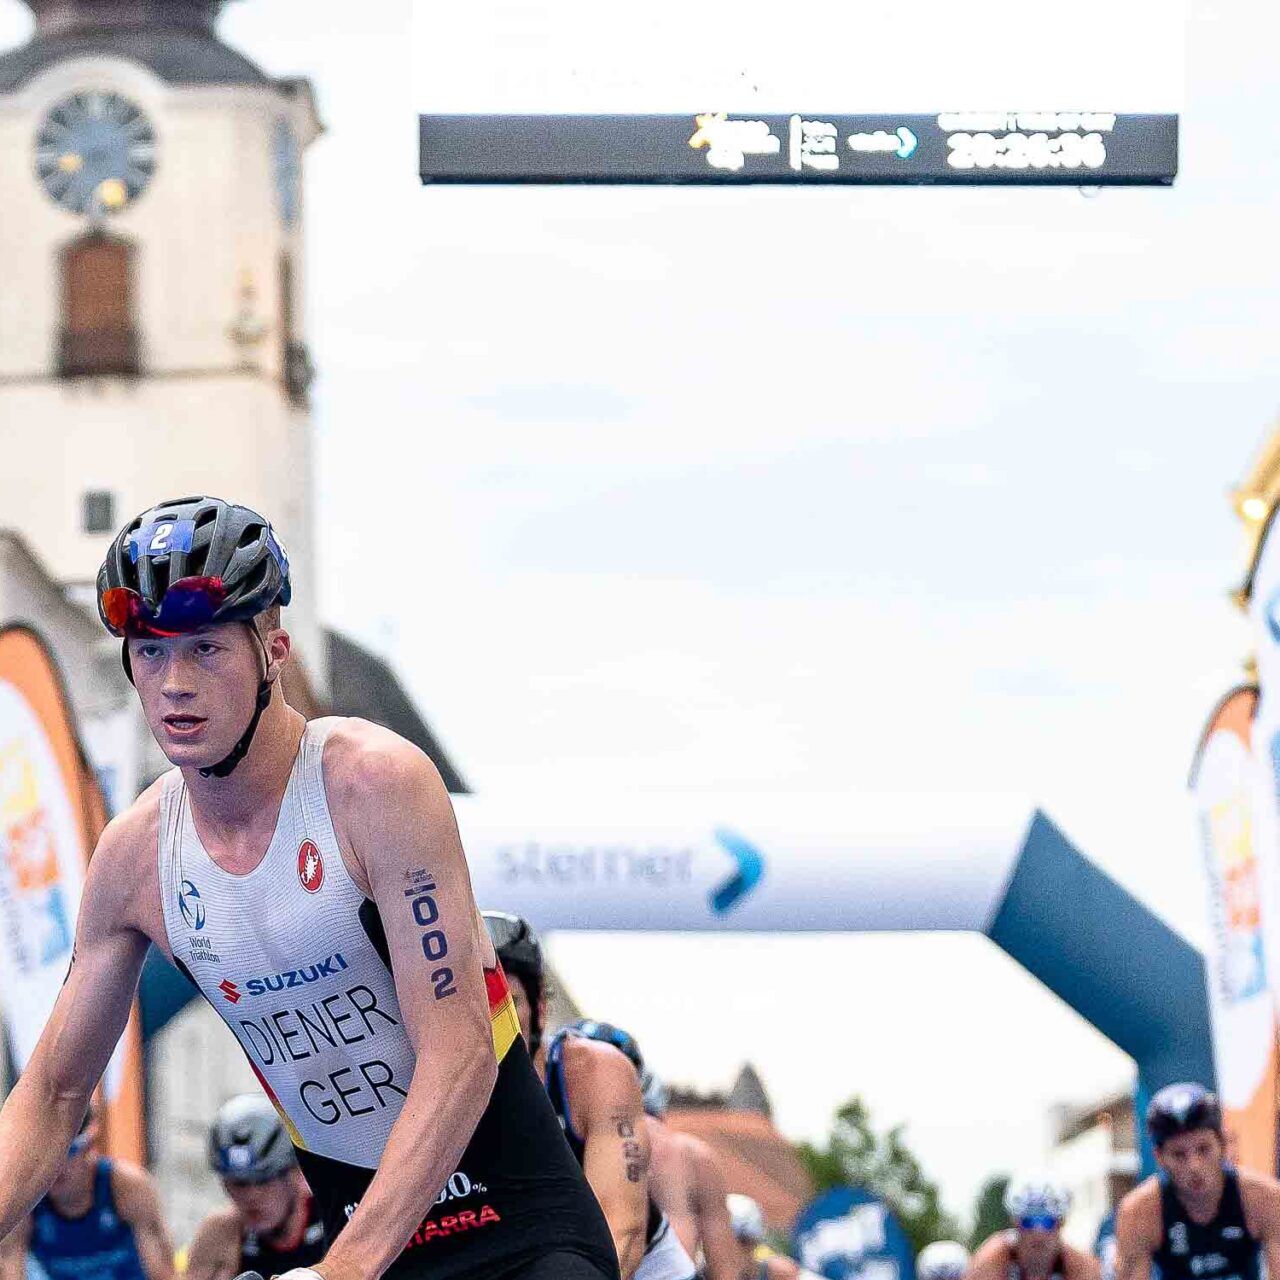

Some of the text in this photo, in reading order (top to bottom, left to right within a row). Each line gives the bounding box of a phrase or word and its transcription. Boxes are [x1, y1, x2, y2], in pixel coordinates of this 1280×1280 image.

[150, 523, 174, 551] 2
[188, 936, 212, 950] World
[188, 949, 221, 964] Triathlon
[411, 895, 459, 1001] 002
[245, 953, 350, 997] SUZUKI
[238, 984, 400, 1067] DIENER
[298, 1059, 410, 1126] GER
